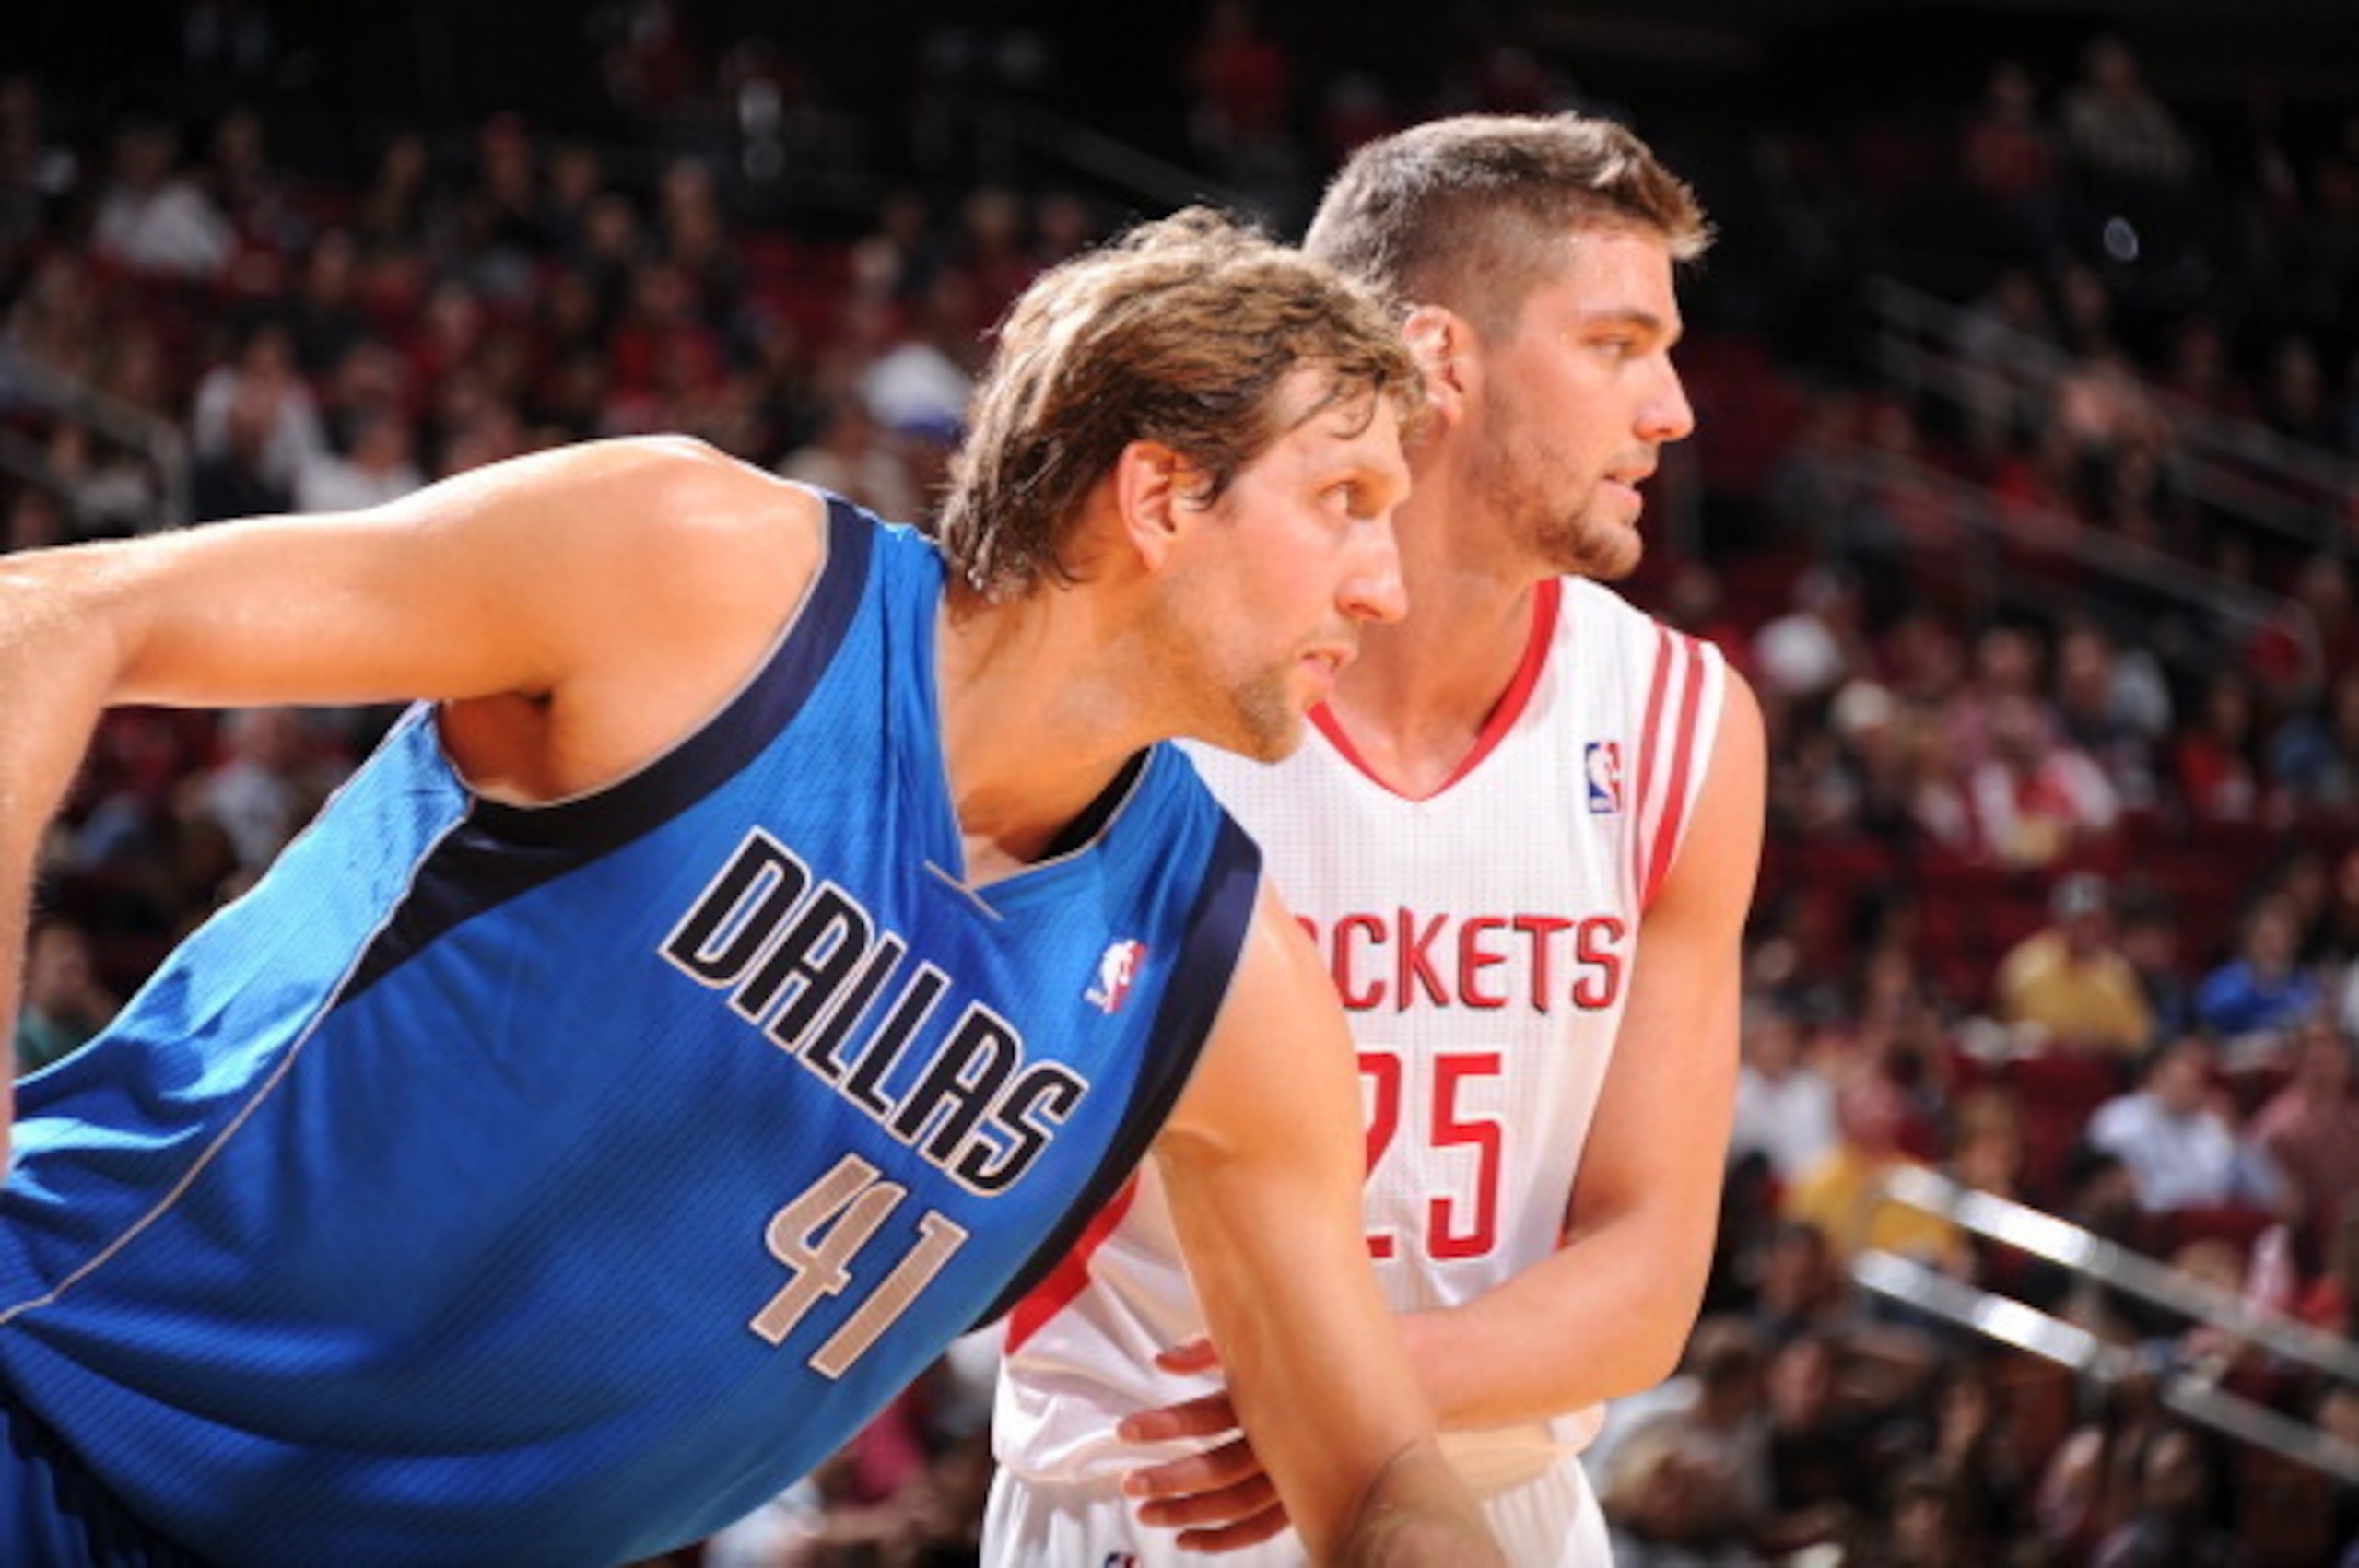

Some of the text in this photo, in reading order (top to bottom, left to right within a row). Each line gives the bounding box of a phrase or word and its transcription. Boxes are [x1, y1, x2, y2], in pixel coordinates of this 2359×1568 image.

[657, 825, 1090, 1199] DALLAS
[1294, 907, 1625, 1014] CKETS
[749, 1153, 970, 1380] 41
